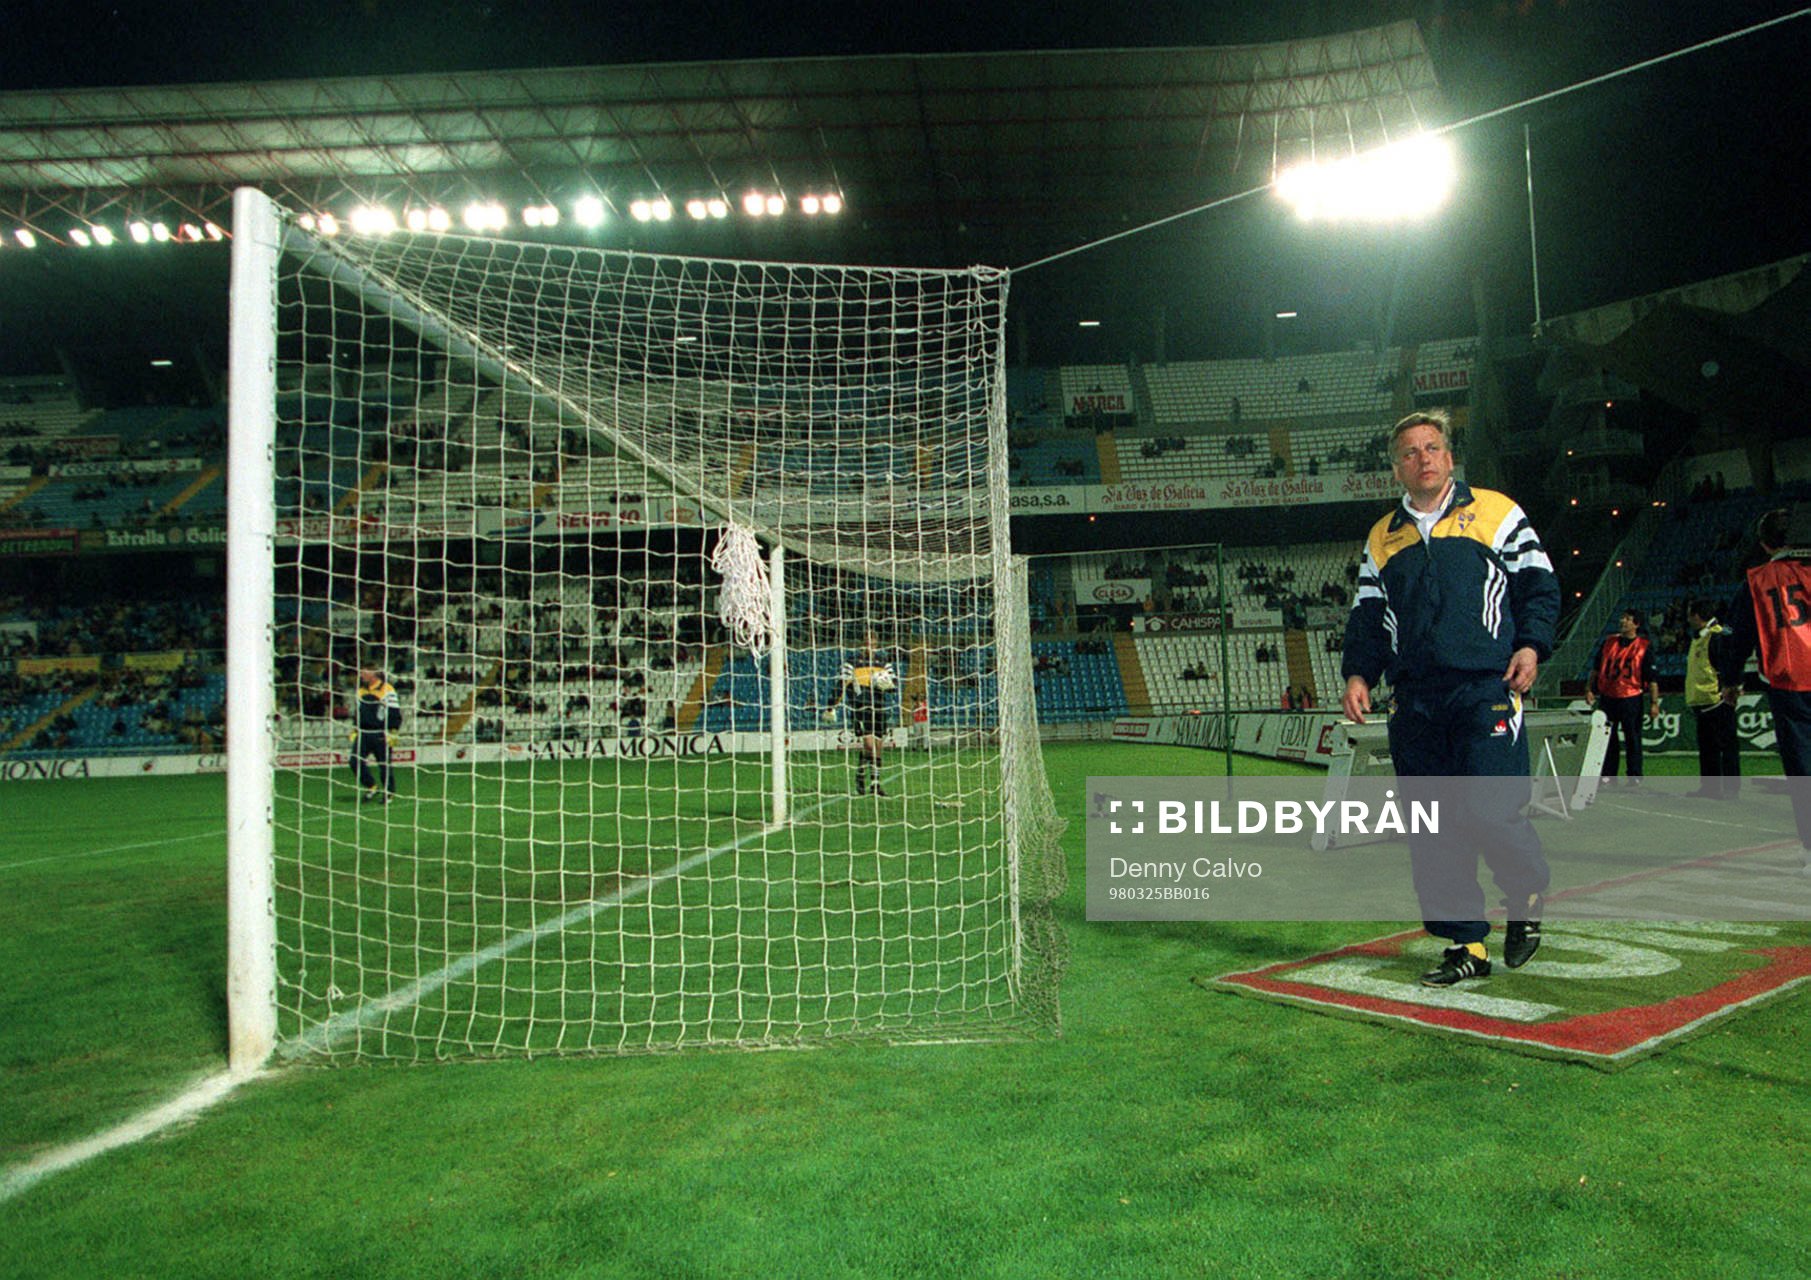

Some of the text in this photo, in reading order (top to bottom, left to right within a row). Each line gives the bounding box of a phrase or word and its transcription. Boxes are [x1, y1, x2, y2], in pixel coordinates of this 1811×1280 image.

[1009, 494, 1070, 508] asa,s.a.
[106, 527, 228, 546] Estrella Galic
[1766, 585, 1808, 628] 15
[619, 735, 724, 757] MONICA
